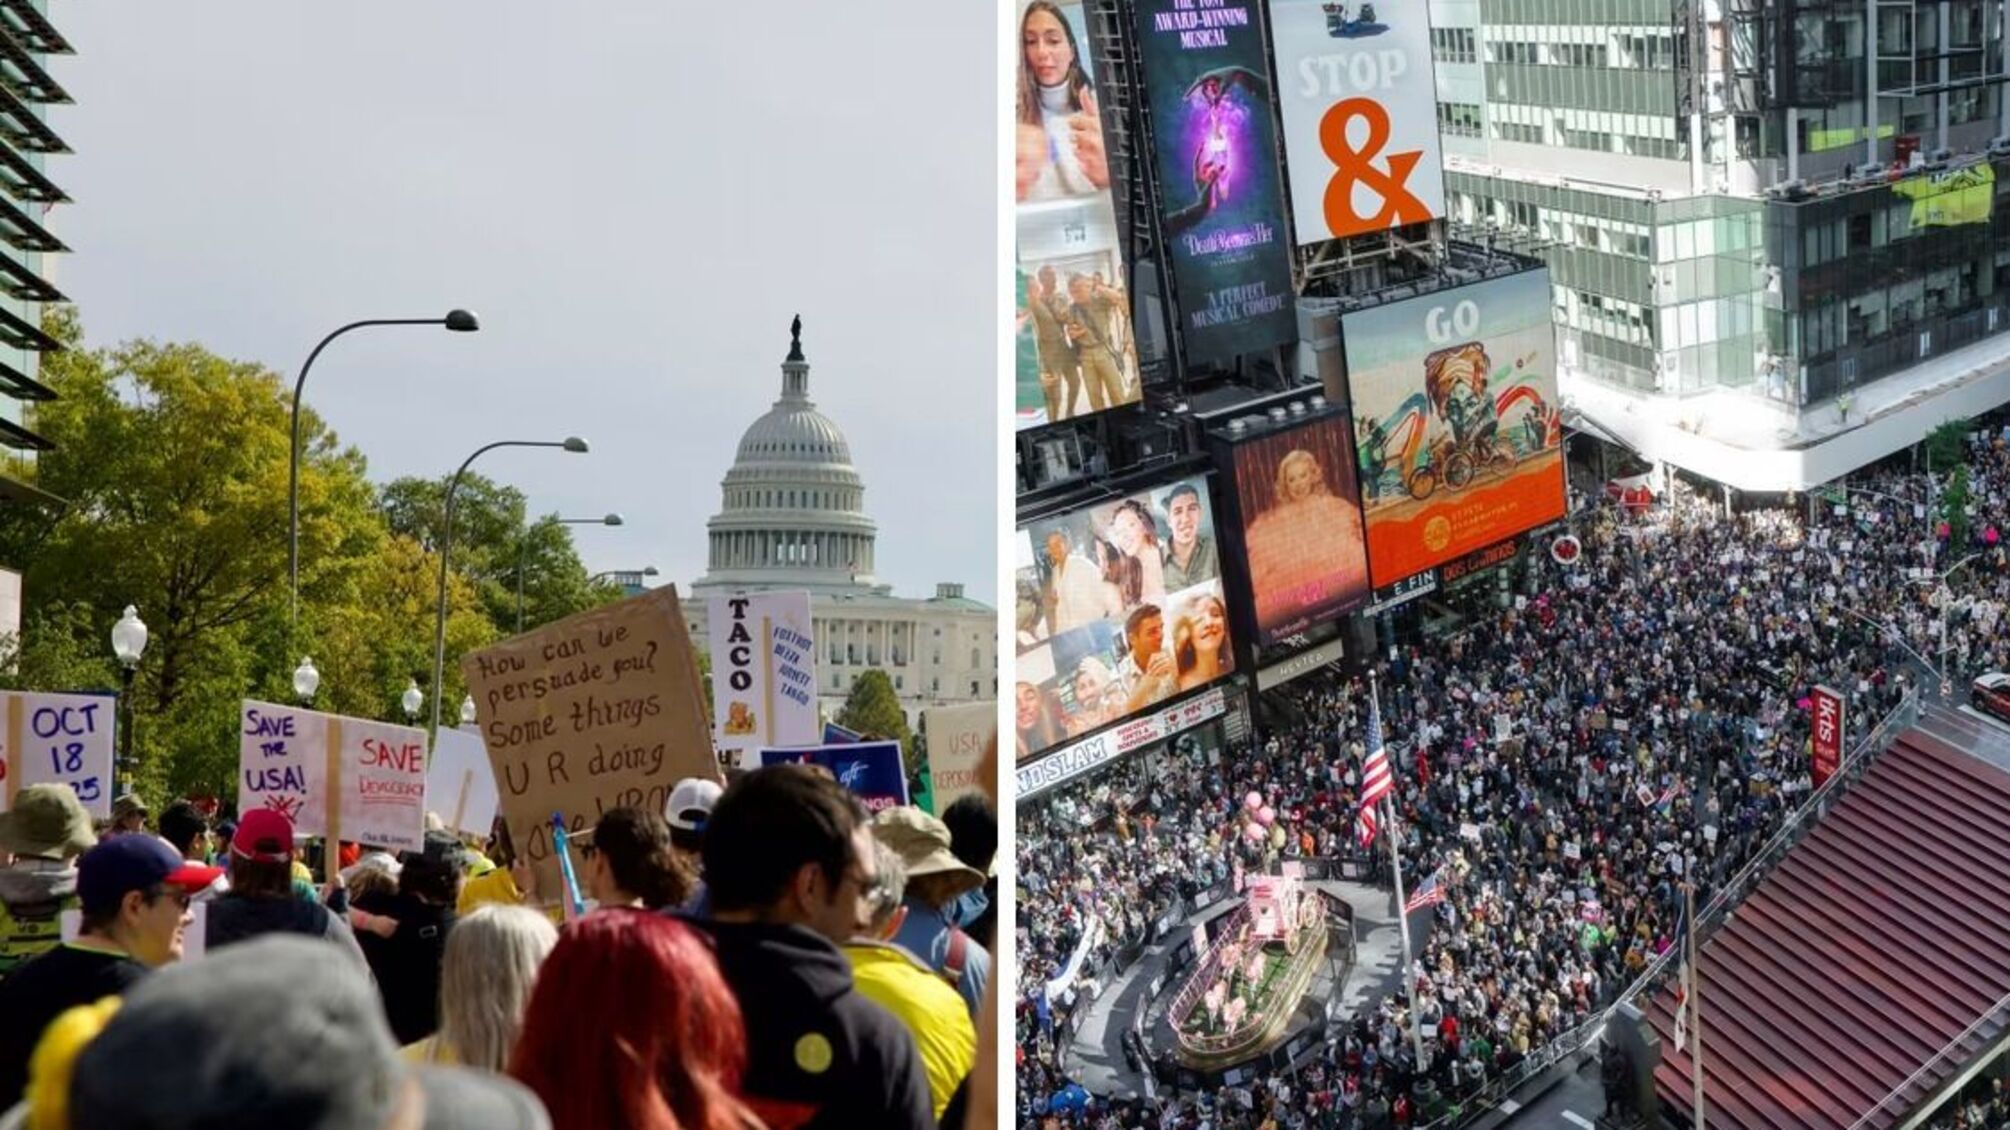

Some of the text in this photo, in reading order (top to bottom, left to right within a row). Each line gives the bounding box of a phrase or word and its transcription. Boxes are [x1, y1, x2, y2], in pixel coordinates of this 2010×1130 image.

[1155, 7, 1248, 32] AWARD-WINNING
[1181, 28, 1229, 49] MUSICAL
[1300, 48, 1408, 98] STOP
[1425, 300, 1480, 342] GO
[477, 625, 630, 680] How can we
[728, 600, 752, 691] TACO
[488, 640, 659, 714] persuade you?
[32, 703, 98, 738] OCT
[244, 709, 296, 737] SAVE
[489, 694, 661, 748] Some things
[1819, 697, 1836, 742] tkts
[51, 743, 84, 774] 18
[259, 741, 288, 758] THE
[360, 738, 423, 773] SAVE
[948, 731, 983, 755] USA
[246, 765, 306, 794] USA!
[506, 743, 666, 796] U R doing
